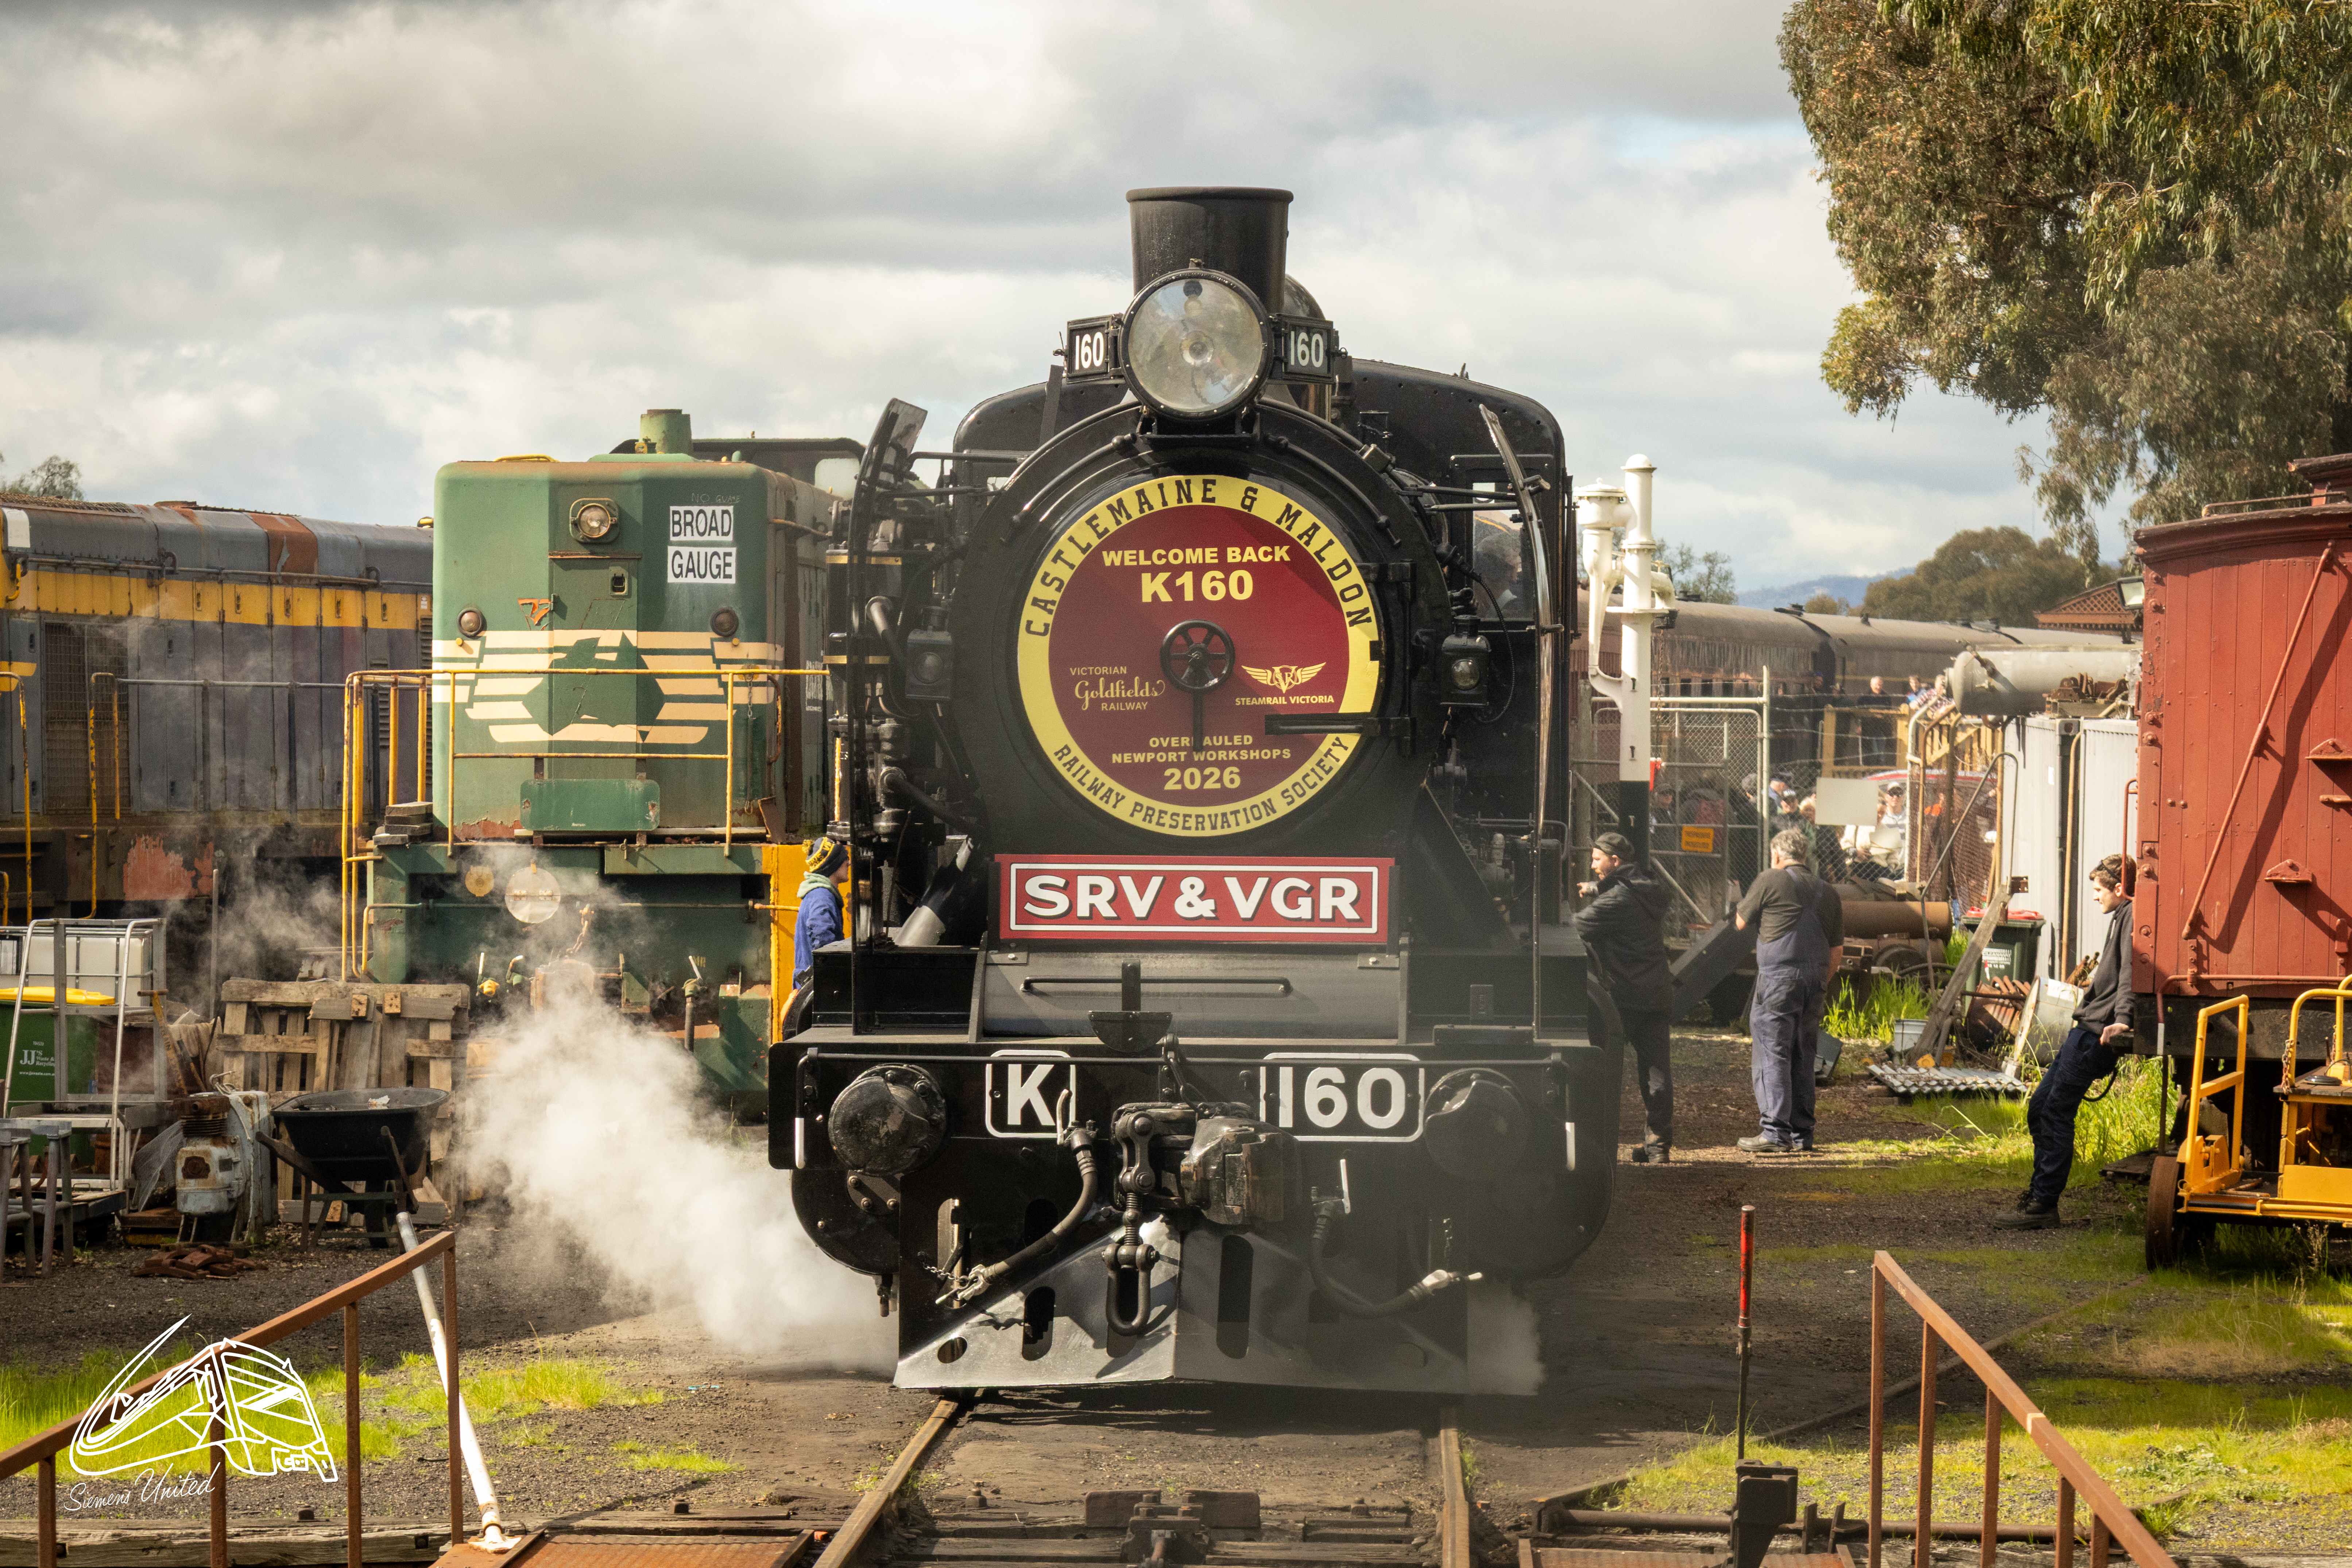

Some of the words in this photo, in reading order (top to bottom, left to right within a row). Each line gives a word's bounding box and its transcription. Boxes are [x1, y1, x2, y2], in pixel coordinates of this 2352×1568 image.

[1075, 331, 1104, 370] 160
[1290, 330, 1324, 368] 160
[692, 493, 710, 503] NO
[672, 509, 732, 537] BROAD
[672, 550, 732, 579] GAUGE
[1025, 479, 1216, 636] CASTLEMAINE
[1241, 486, 1257, 512] &
[1275, 503, 1372, 627] MALDON
[1102, 547, 1219, 566] WELCOME
[1227, 546, 1291, 563] BACK
[1141, 570, 1254, 603] K160
[1070, 666, 1127, 675] VICTORIAN
[1075, 676, 1165, 710] Goldfields
[1101, 701, 1148, 711] RAILWAY
[1235, 696, 1287, 705] STEAMRAIL
[1289, 695, 1335, 704] VICTORIA
[1112, 751, 1187, 763] NEWPORT
[1193, 748, 1291, 761] WORKSHOPS
[1149, 735, 1253, 747] OVERAULED
[1054, 744, 1126, 810] RAILWAY
[1129, 797, 1276, 831] PRESERVATION
[1281, 737, 1349, 806] SOCIETY
[1164, 766, 1241, 790] 2026
[1023, 875, 1166, 919] SRV
[1174, 876, 1217, 919] &
[1224, 877, 1361, 921] VGR
[1007, 1063, 1056, 1126] K
[1279, 1067, 1406, 1129] 160
